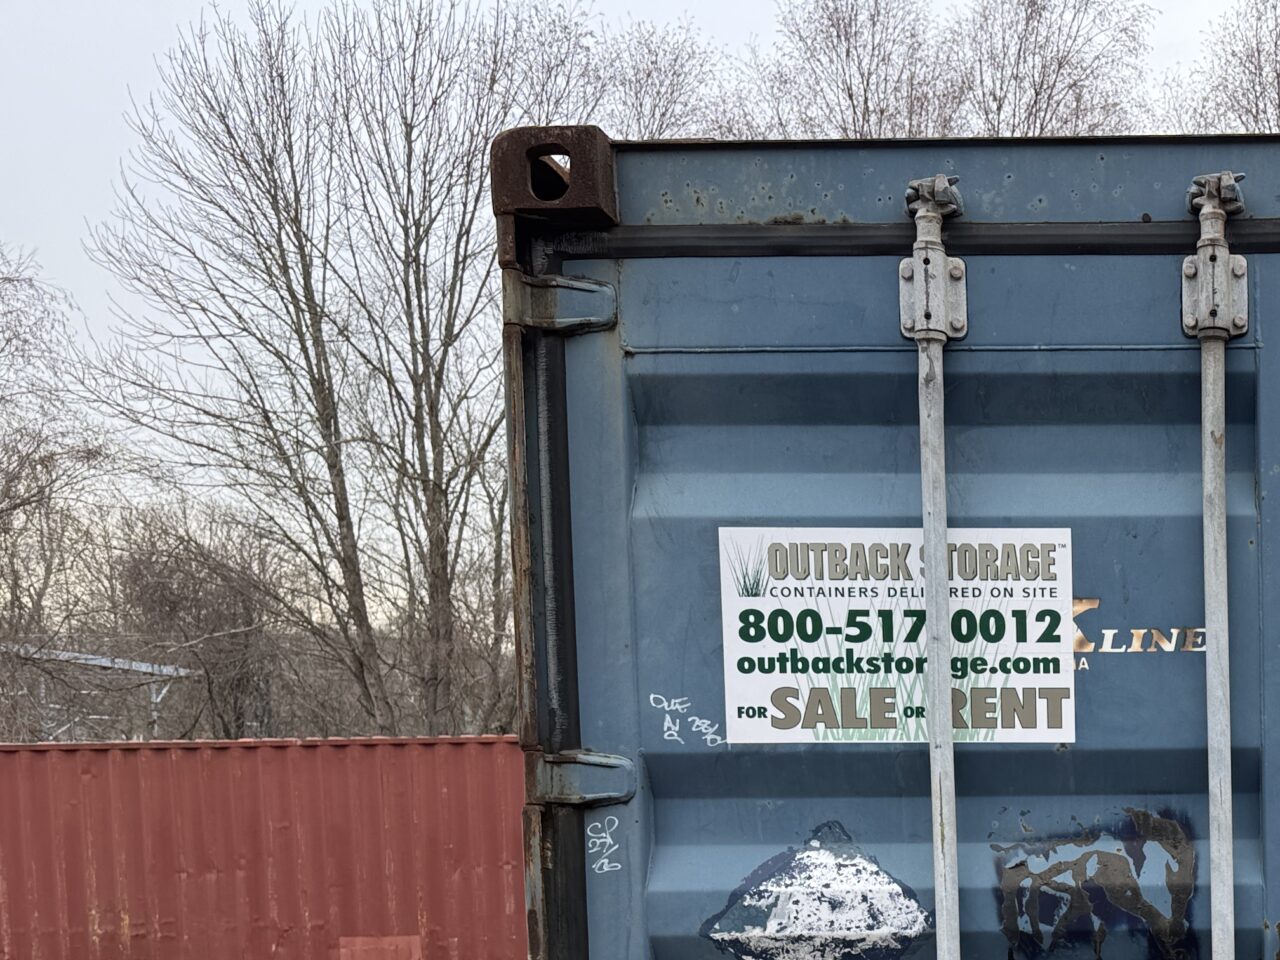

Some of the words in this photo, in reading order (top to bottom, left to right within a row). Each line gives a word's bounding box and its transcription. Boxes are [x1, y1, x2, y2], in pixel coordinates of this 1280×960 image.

[767, 543, 914, 581] OUTBACK
[919, 543, 1057, 581] TORAGE
[770, 586, 879, 598] CONTAINERS
[887, 587, 982, 598] DELIRED
[990, 587, 1014, 598] ON
[1022, 587, 1058, 598] SITE
[738, 608, 1062, 644] 800-5170012
[1099, 628, 1207, 652] LINE
[737, 648, 1062, 680] outbackstorge.com
[737, 707, 768, 719] FOR
[770, 686, 897, 730] SALE
[903, 706, 926, 718] OR
